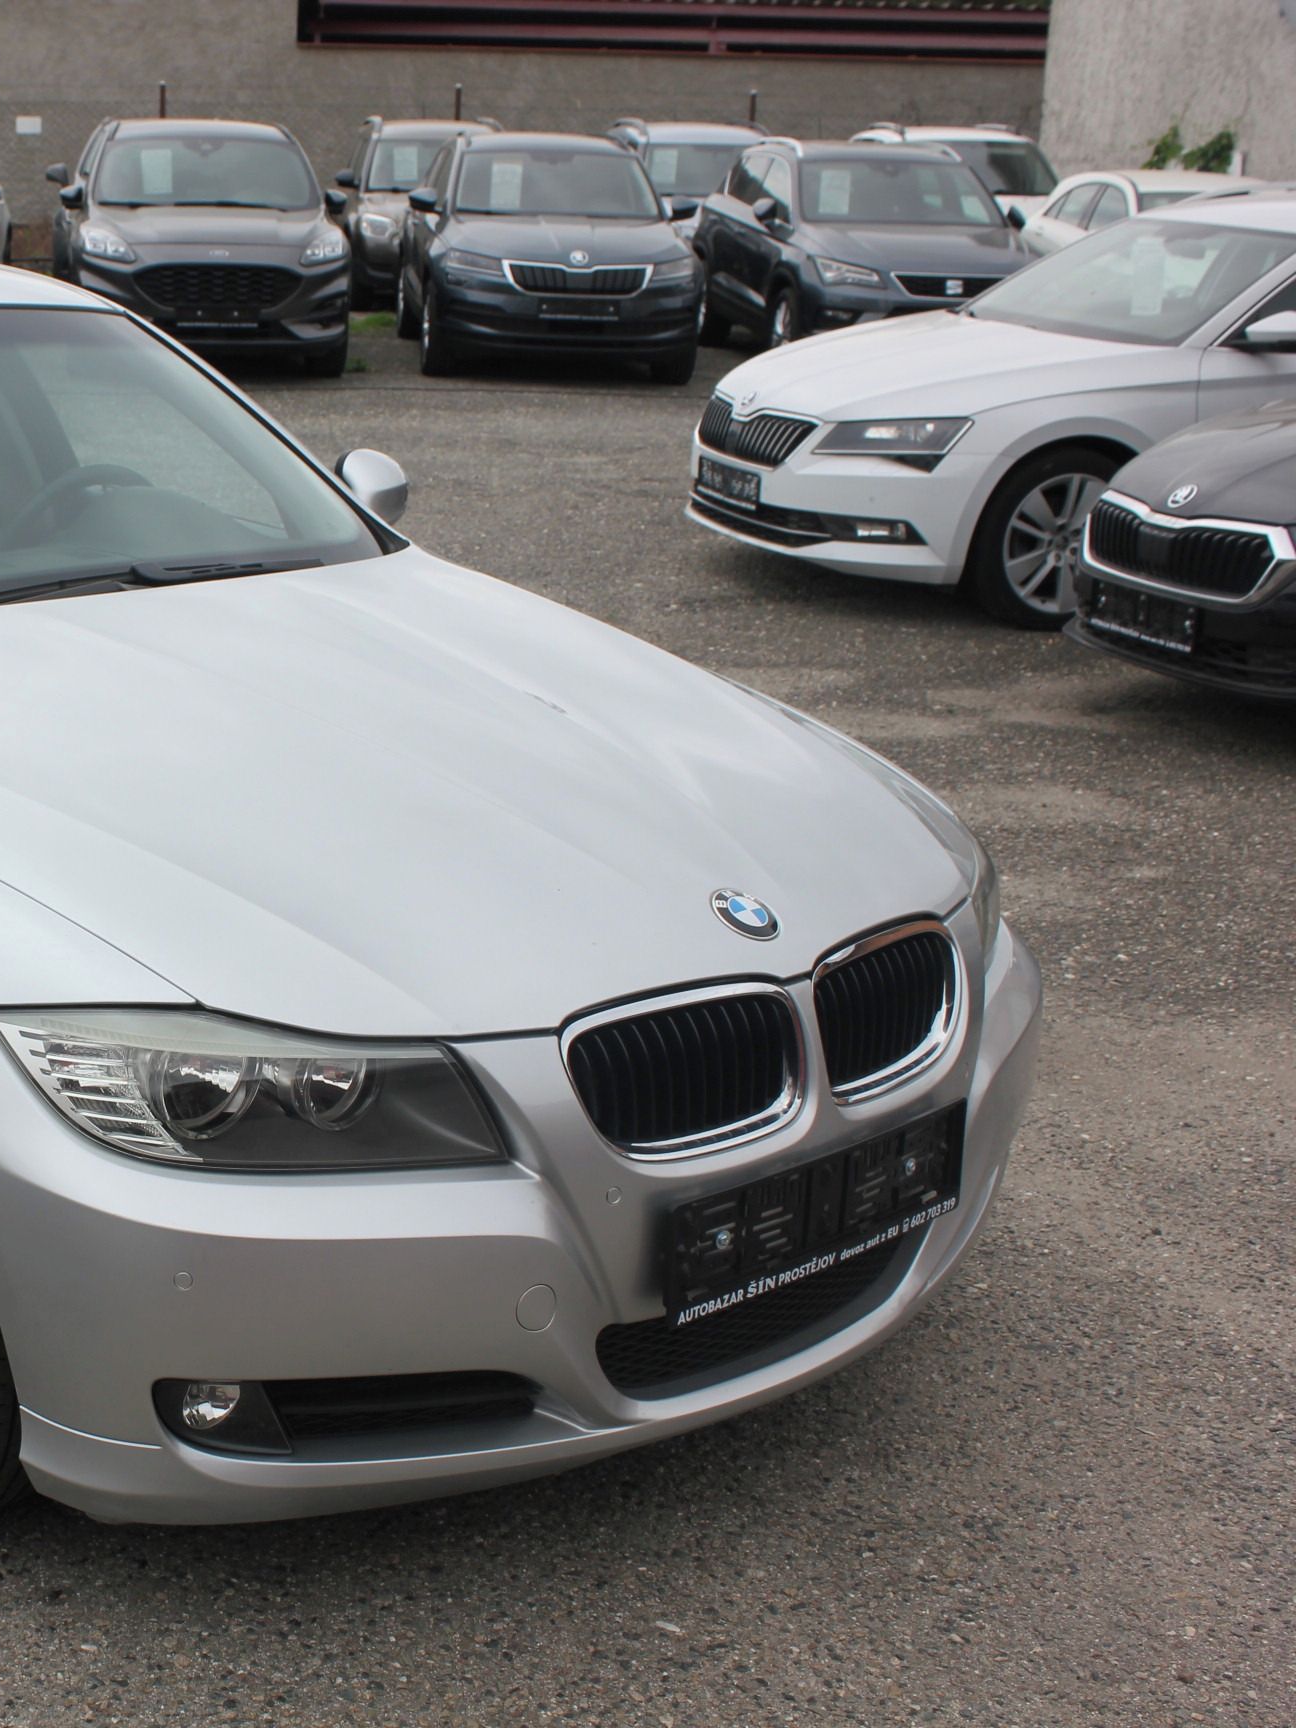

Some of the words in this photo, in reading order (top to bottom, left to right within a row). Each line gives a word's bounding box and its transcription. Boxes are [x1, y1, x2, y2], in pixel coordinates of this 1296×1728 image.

[677, 1288, 744, 1325] AUTOBAZAR
[746, 1276, 777, 1298] ŠÍN
[778, 1252, 836, 1286] PROSTĚJOV
[887, 1224, 899, 1240] EU
[910, 1211, 925, 1228] 602
[926, 1204, 941, 1220] 703
